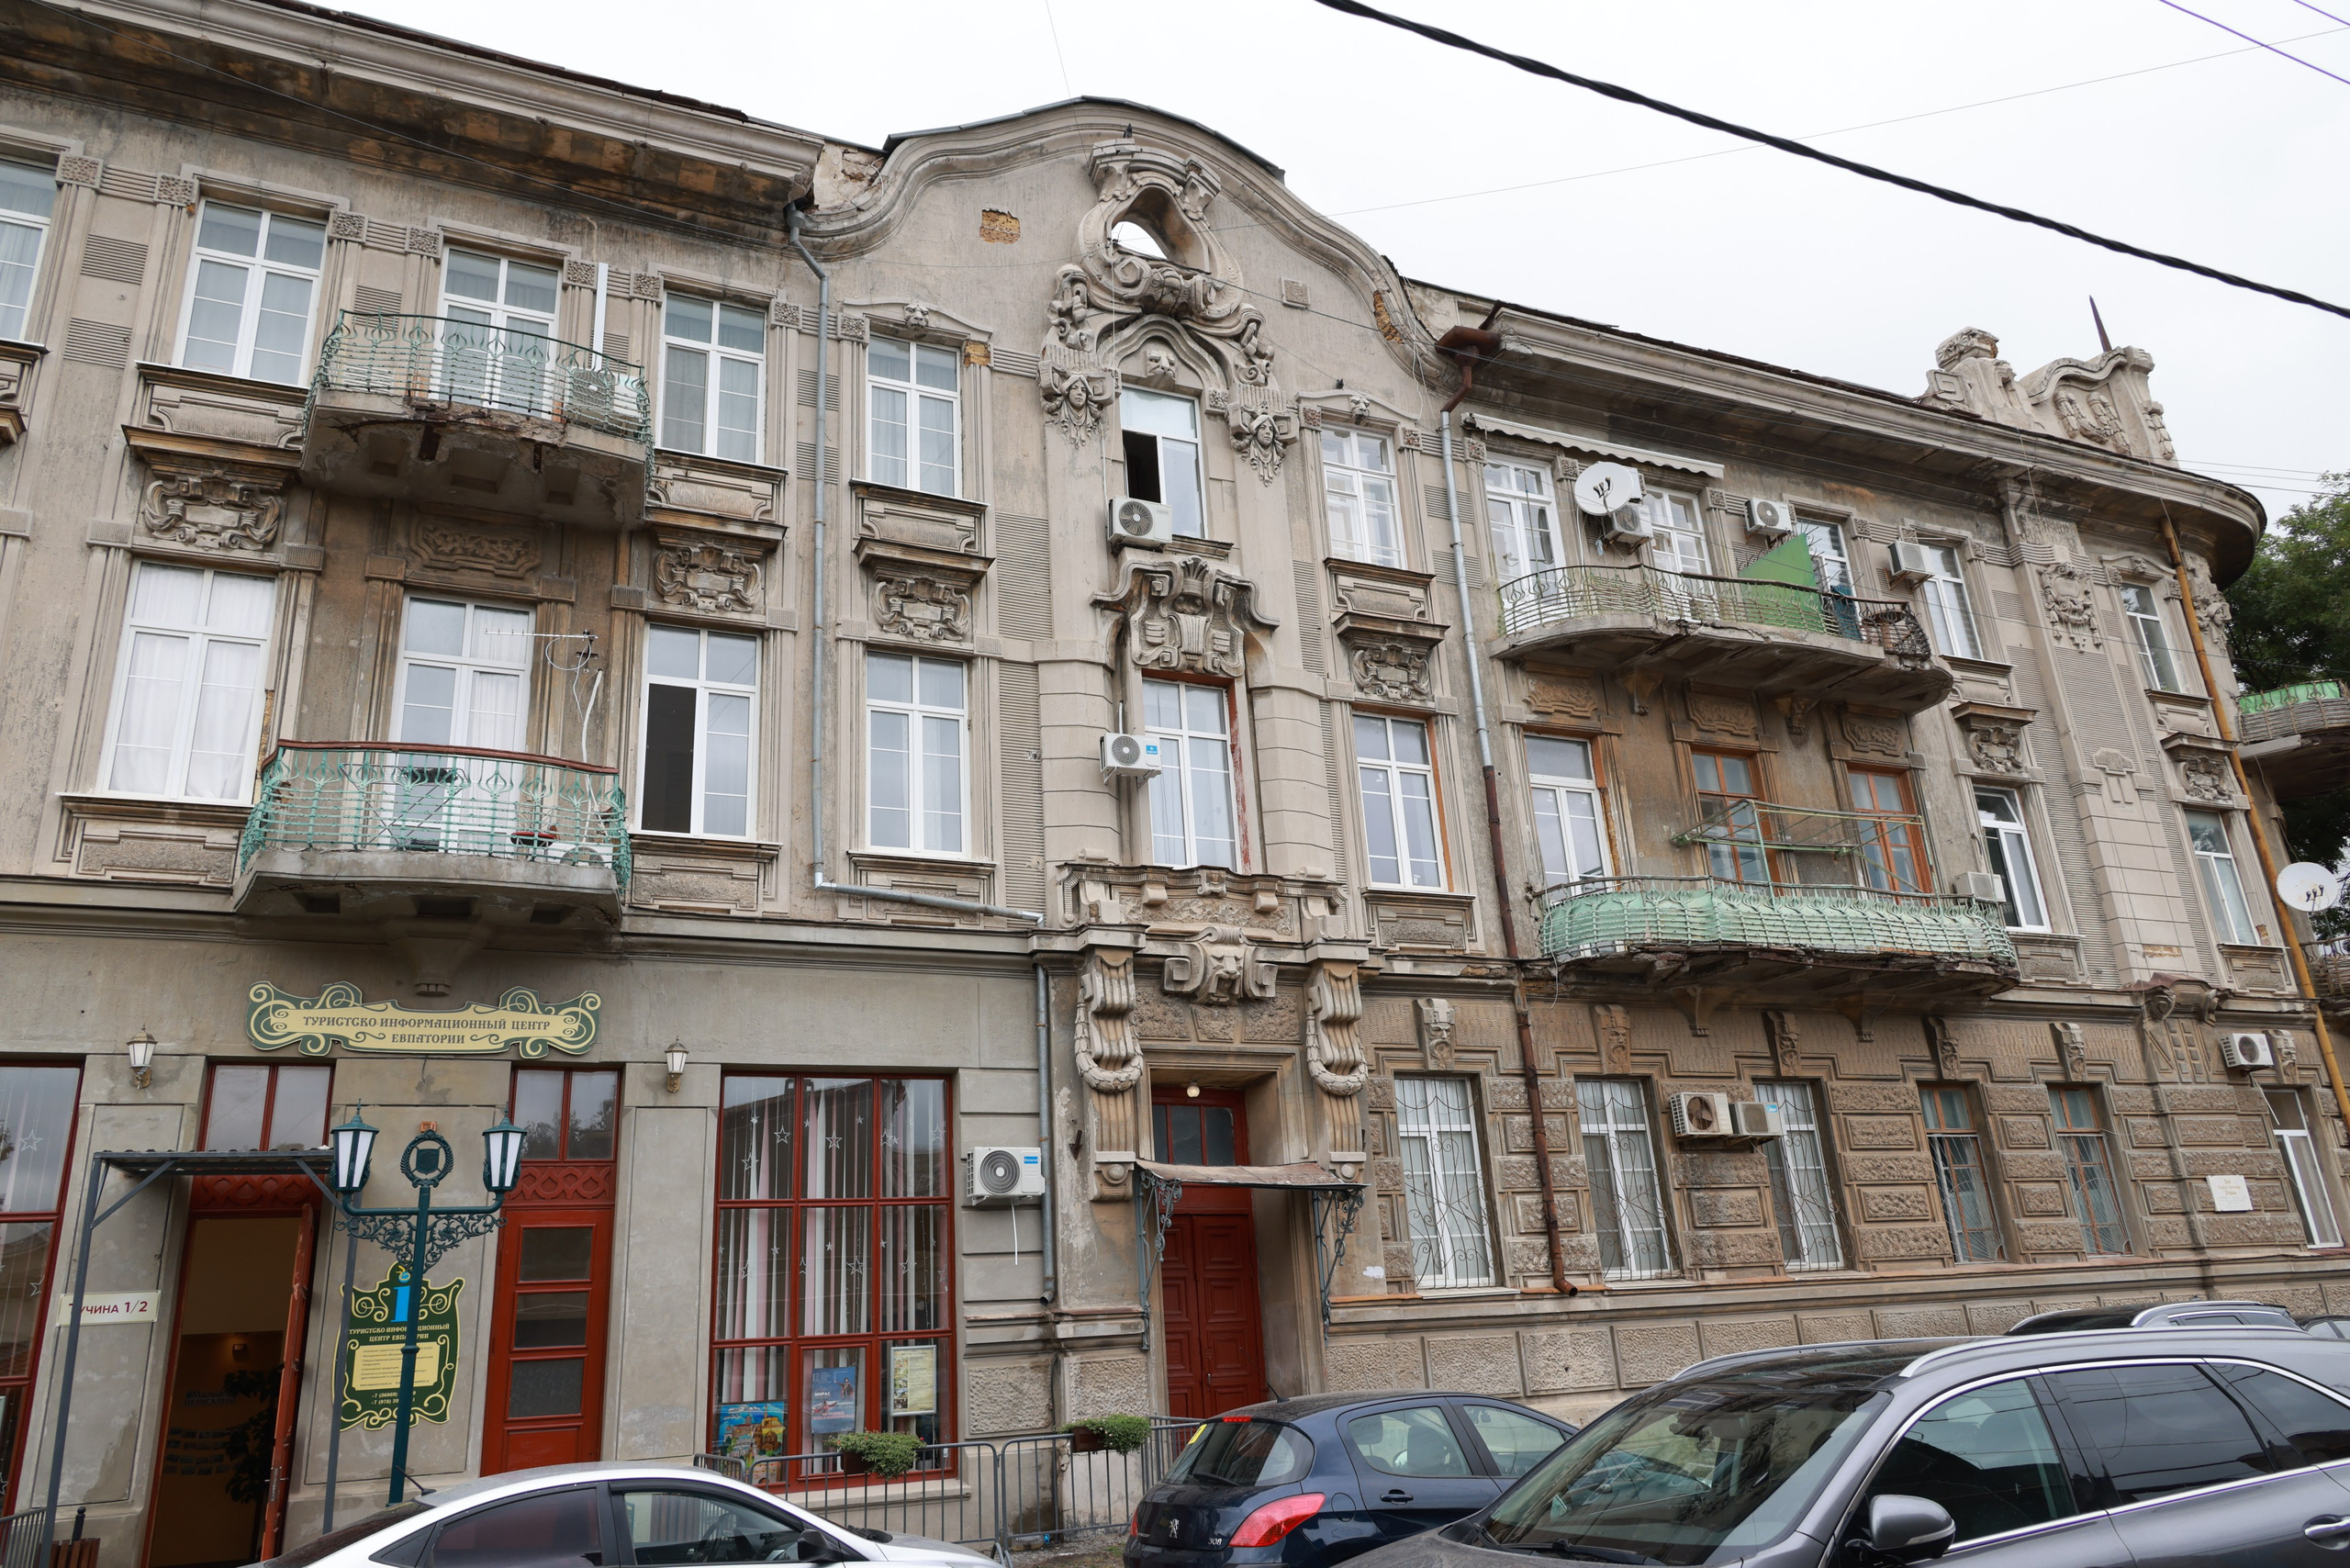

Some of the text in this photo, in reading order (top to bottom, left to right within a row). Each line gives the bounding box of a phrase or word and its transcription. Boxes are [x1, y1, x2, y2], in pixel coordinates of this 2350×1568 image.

[511, 1020, 550, 1031] ЦЕНТР
[391, 1034, 465, 1044] ЕВПАТОРИИ
[124, 1299, 148, 1314] 1/2
[392, 1333, 429, 1341] ЕВПРИИ
[1208, 1537, 1223, 1545] 308
